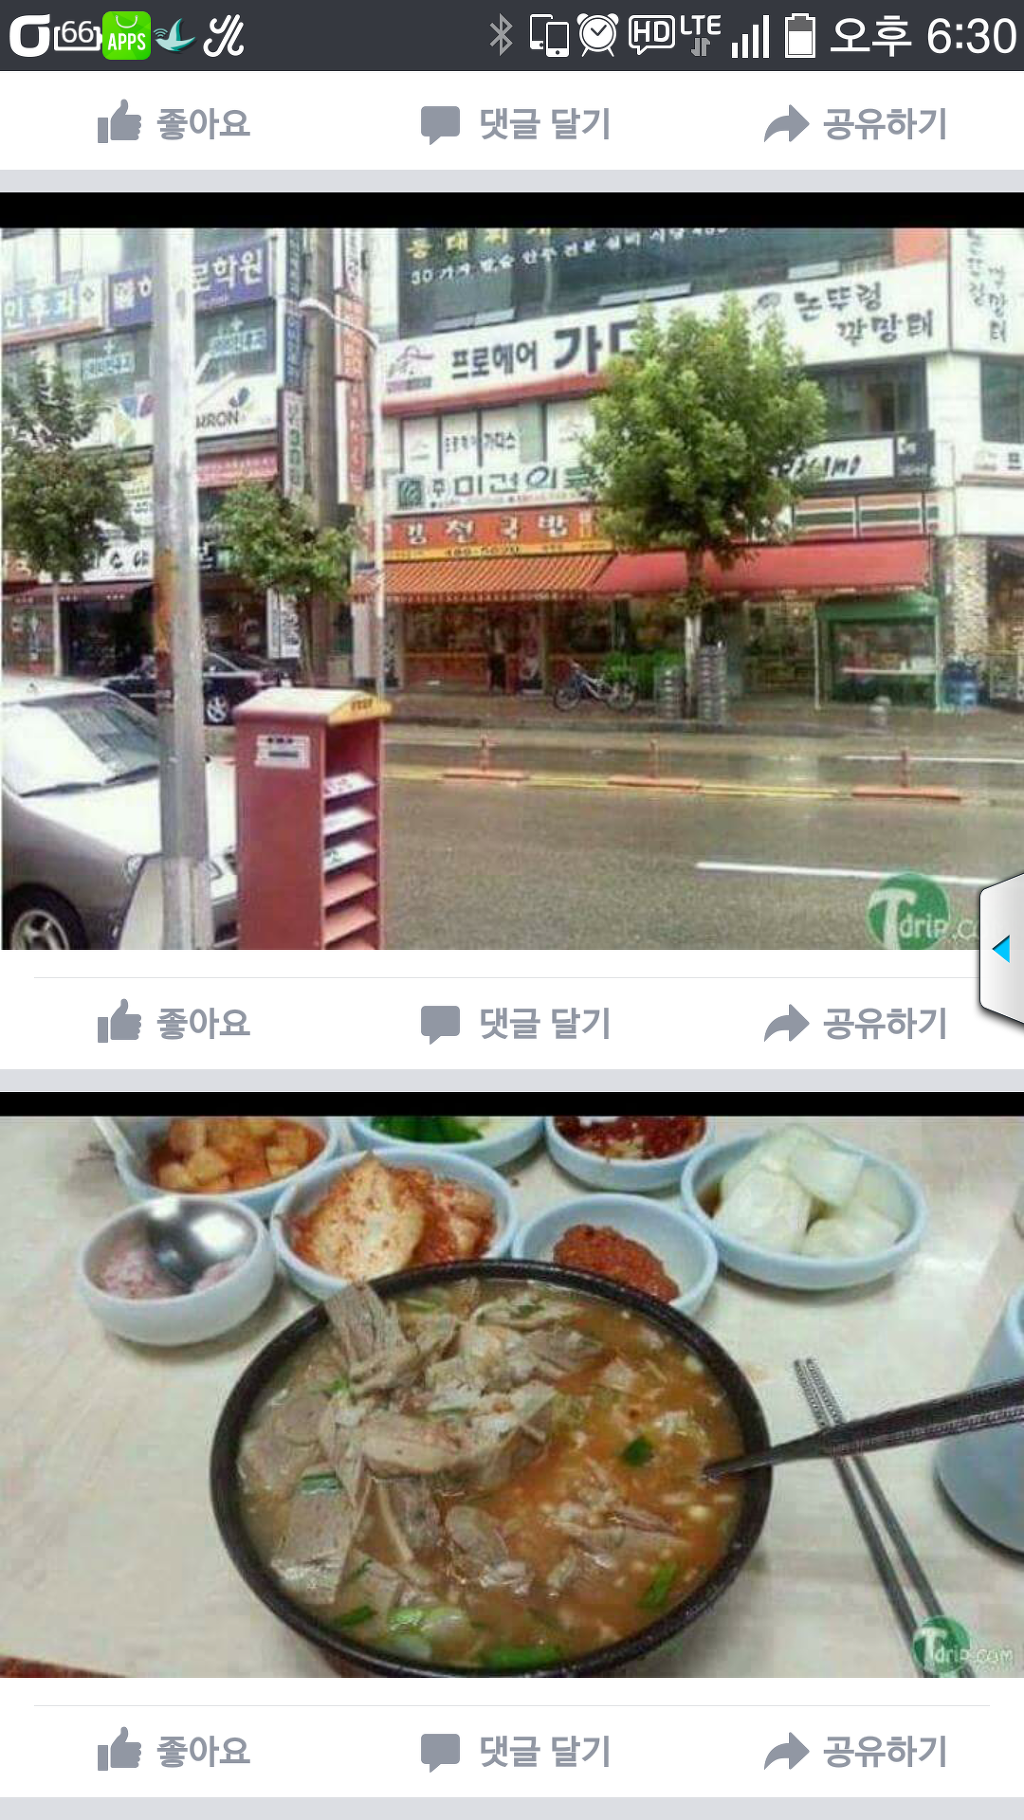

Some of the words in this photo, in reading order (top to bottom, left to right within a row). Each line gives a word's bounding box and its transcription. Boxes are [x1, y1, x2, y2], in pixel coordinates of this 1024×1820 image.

[61, 20, 94, 44] 66
[107, 32, 146, 51] APPS
[633, 20, 671, 43] HD
[680, 14, 722, 36] LTE
[830, 14, 913, 58] 오후
[926, 17, 1018, 55] 6:30
[156, 107, 251, 140] 좋아요
[480, 107, 541, 139] 댓글
[551, 107, 610, 139] 달기
[823, 107, 946, 140] 공유하기
[451, 341, 538, 380] 프로헤어
[156, 1007, 251, 1040] 좋아요
[480, 1007, 541, 1039] 댓글
[551, 1007, 610, 1039] 달기
[823, 1007, 946, 1040] 공유하기
[156, 1735, 251, 1768] 좋아요
[480, 1735, 541, 1767] 댓글
[551, 1735, 610, 1767] 달기
[823, 1735, 946, 1768] 공유하기
